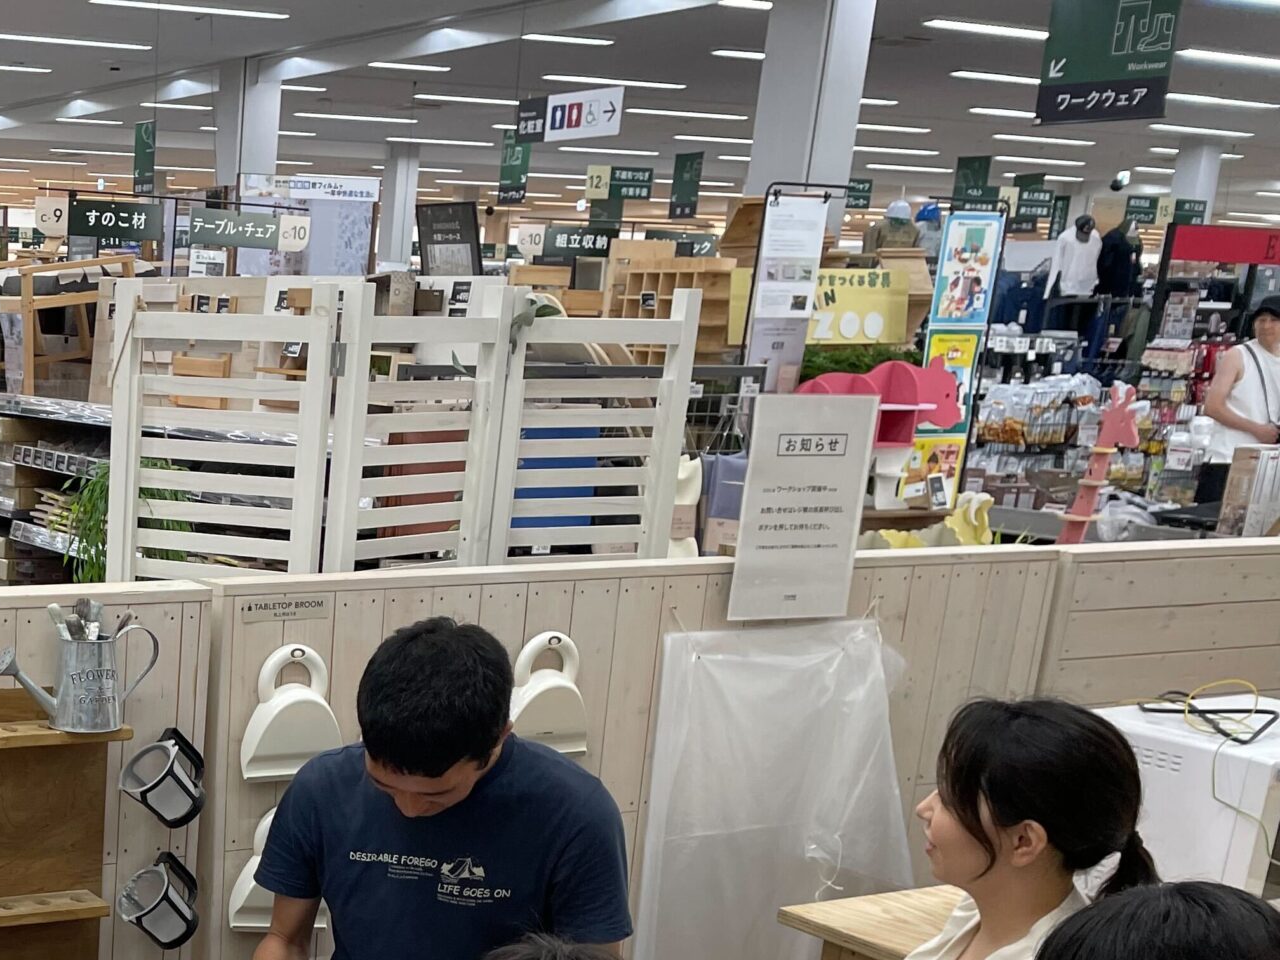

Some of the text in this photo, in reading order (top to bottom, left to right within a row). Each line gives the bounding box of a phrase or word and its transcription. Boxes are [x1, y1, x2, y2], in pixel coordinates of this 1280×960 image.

[1128, 61, 1167, 71] Workwear
[1057, 88, 1148, 111] ワークウェア
[519, 119, 544, 134] 化粧室
[41, 208, 63, 223] C-9
[86, 210, 147, 229] すのこ材
[193, 218, 276, 238] テーブル・チェア
[556, 234, 608, 249] 組立収納
[812, 311, 884, 339] ZOO
[785, 438, 840, 452] お知らせ
[254, 600, 324, 612] TABLETOP BROOM
[350, 851, 438, 869] DESIRABLE FOREGO
[437, 883, 511, 898] LIFE GOES ON
